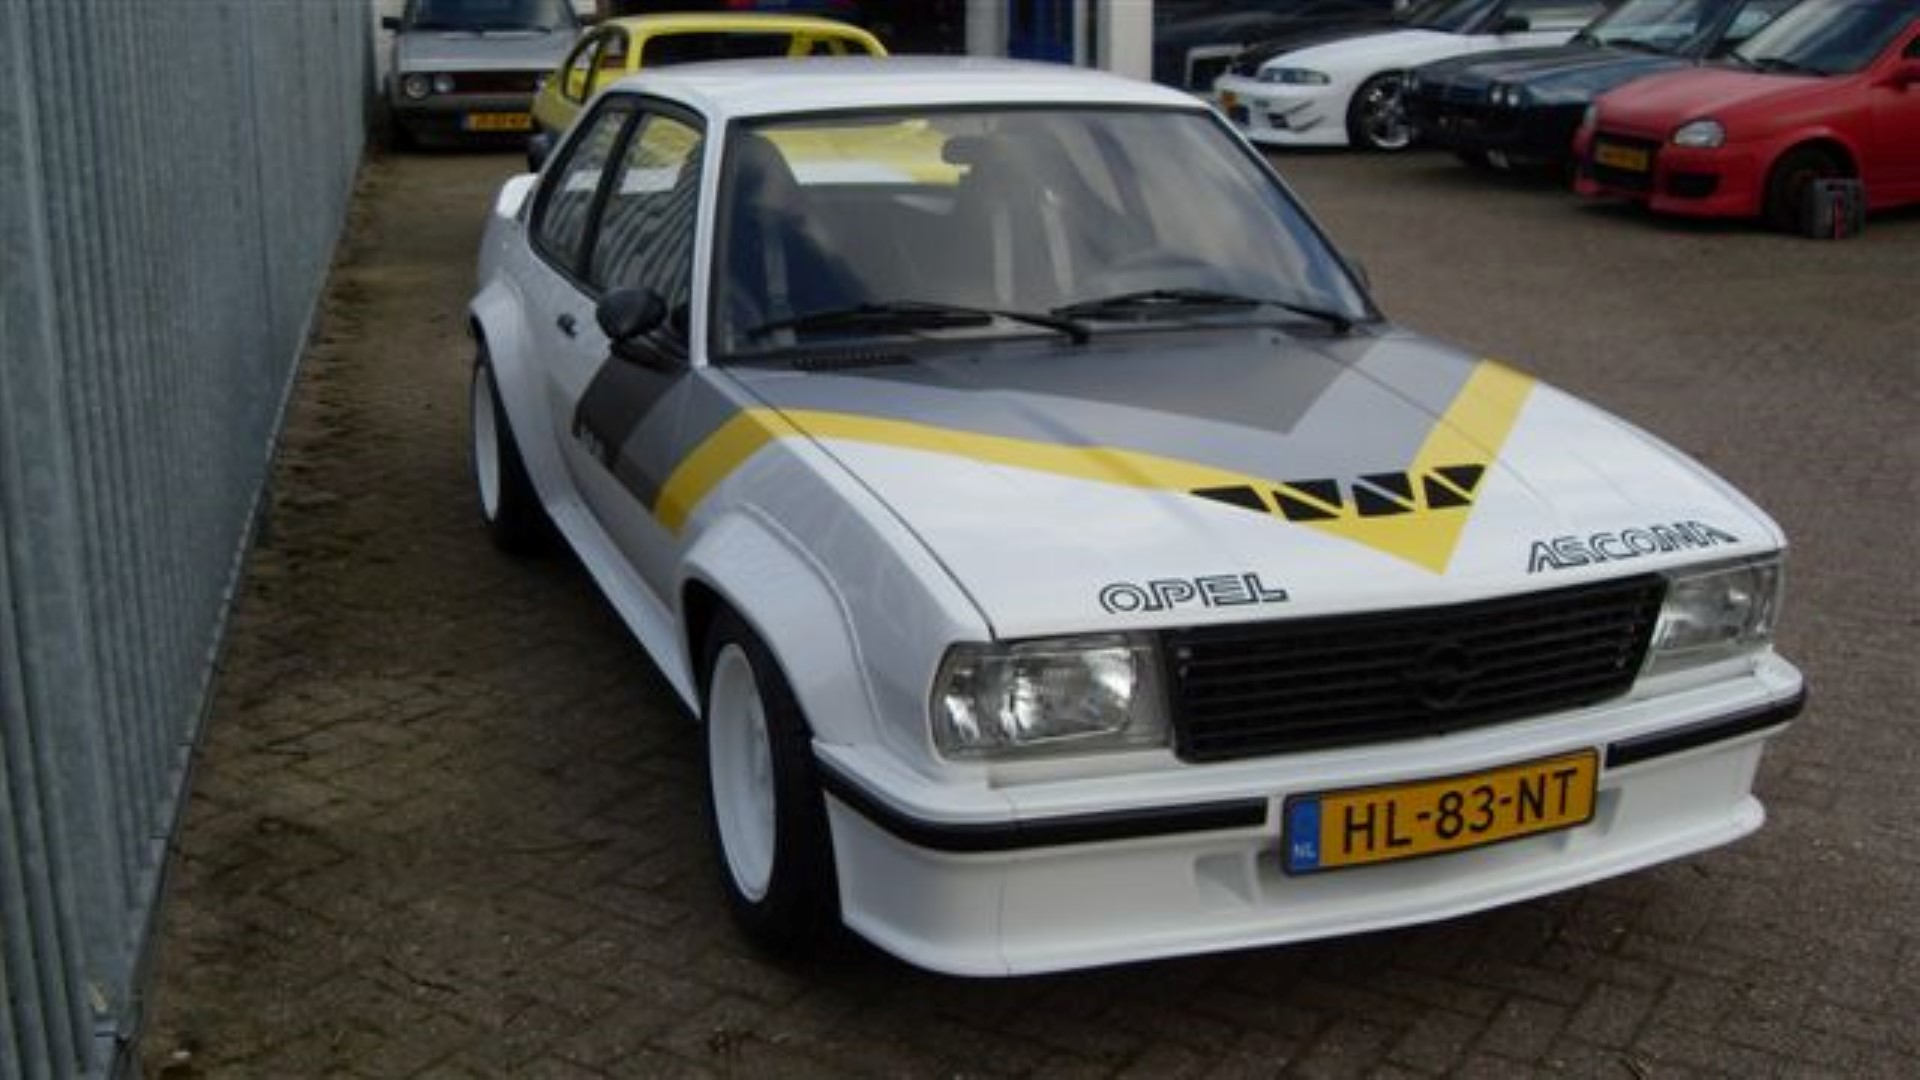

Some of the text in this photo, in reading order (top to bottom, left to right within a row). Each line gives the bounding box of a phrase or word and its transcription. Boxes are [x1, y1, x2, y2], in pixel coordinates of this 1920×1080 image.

[1527, 520, 1739, 574] ASCONA
[1099, 572, 1289, 615] OPEL
[1342, 767, 1578, 854] HL-83-NT
[1293, 842, 1317, 858] NL
